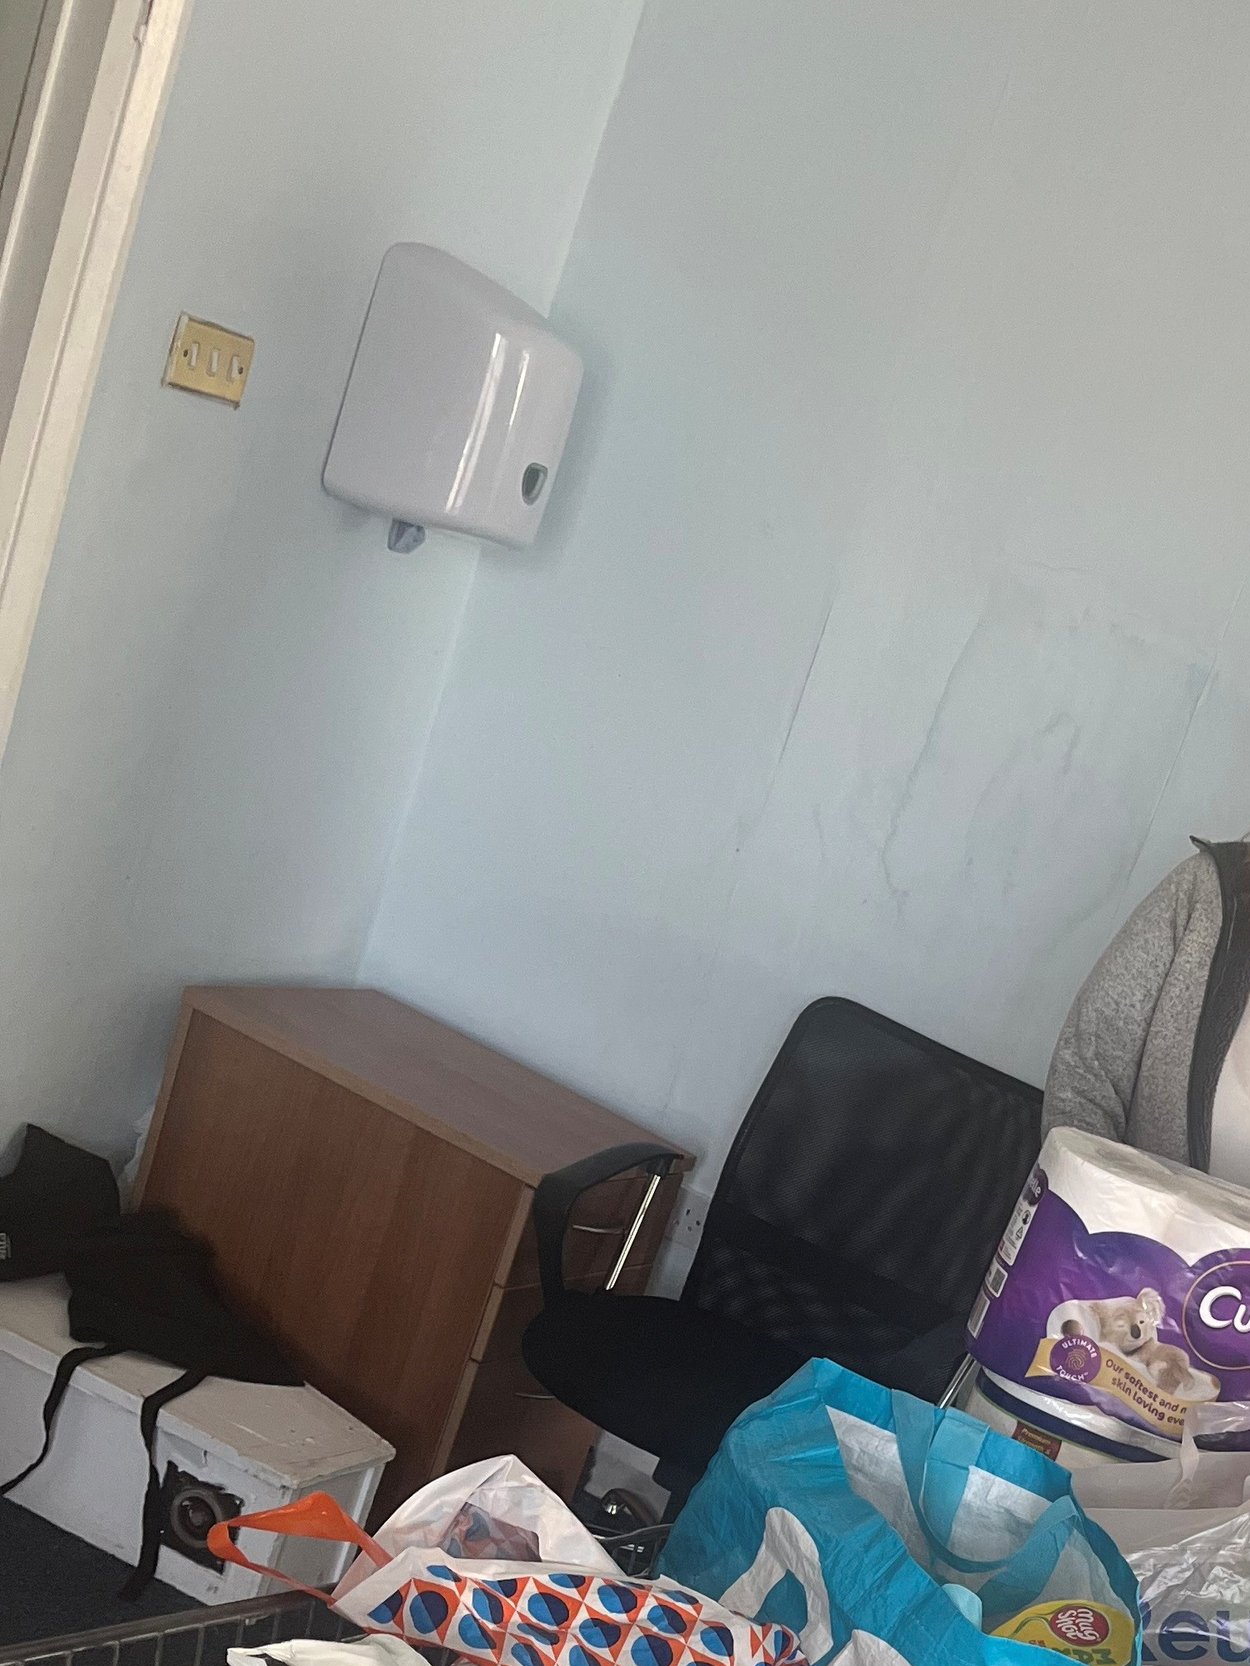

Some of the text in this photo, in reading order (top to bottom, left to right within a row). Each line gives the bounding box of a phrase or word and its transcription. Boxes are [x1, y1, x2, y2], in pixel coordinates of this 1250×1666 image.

[1062, 1338, 1098, 1358] ULTIMATE
[1105, 1357, 1124, 1375] Our
[1124, 1367, 1159, 1405] softest
[1159, 1395, 1179, 1413] and
[1111, 1376, 1133, 1398] skin
[1133, 1391, 1165, 1421] loving
